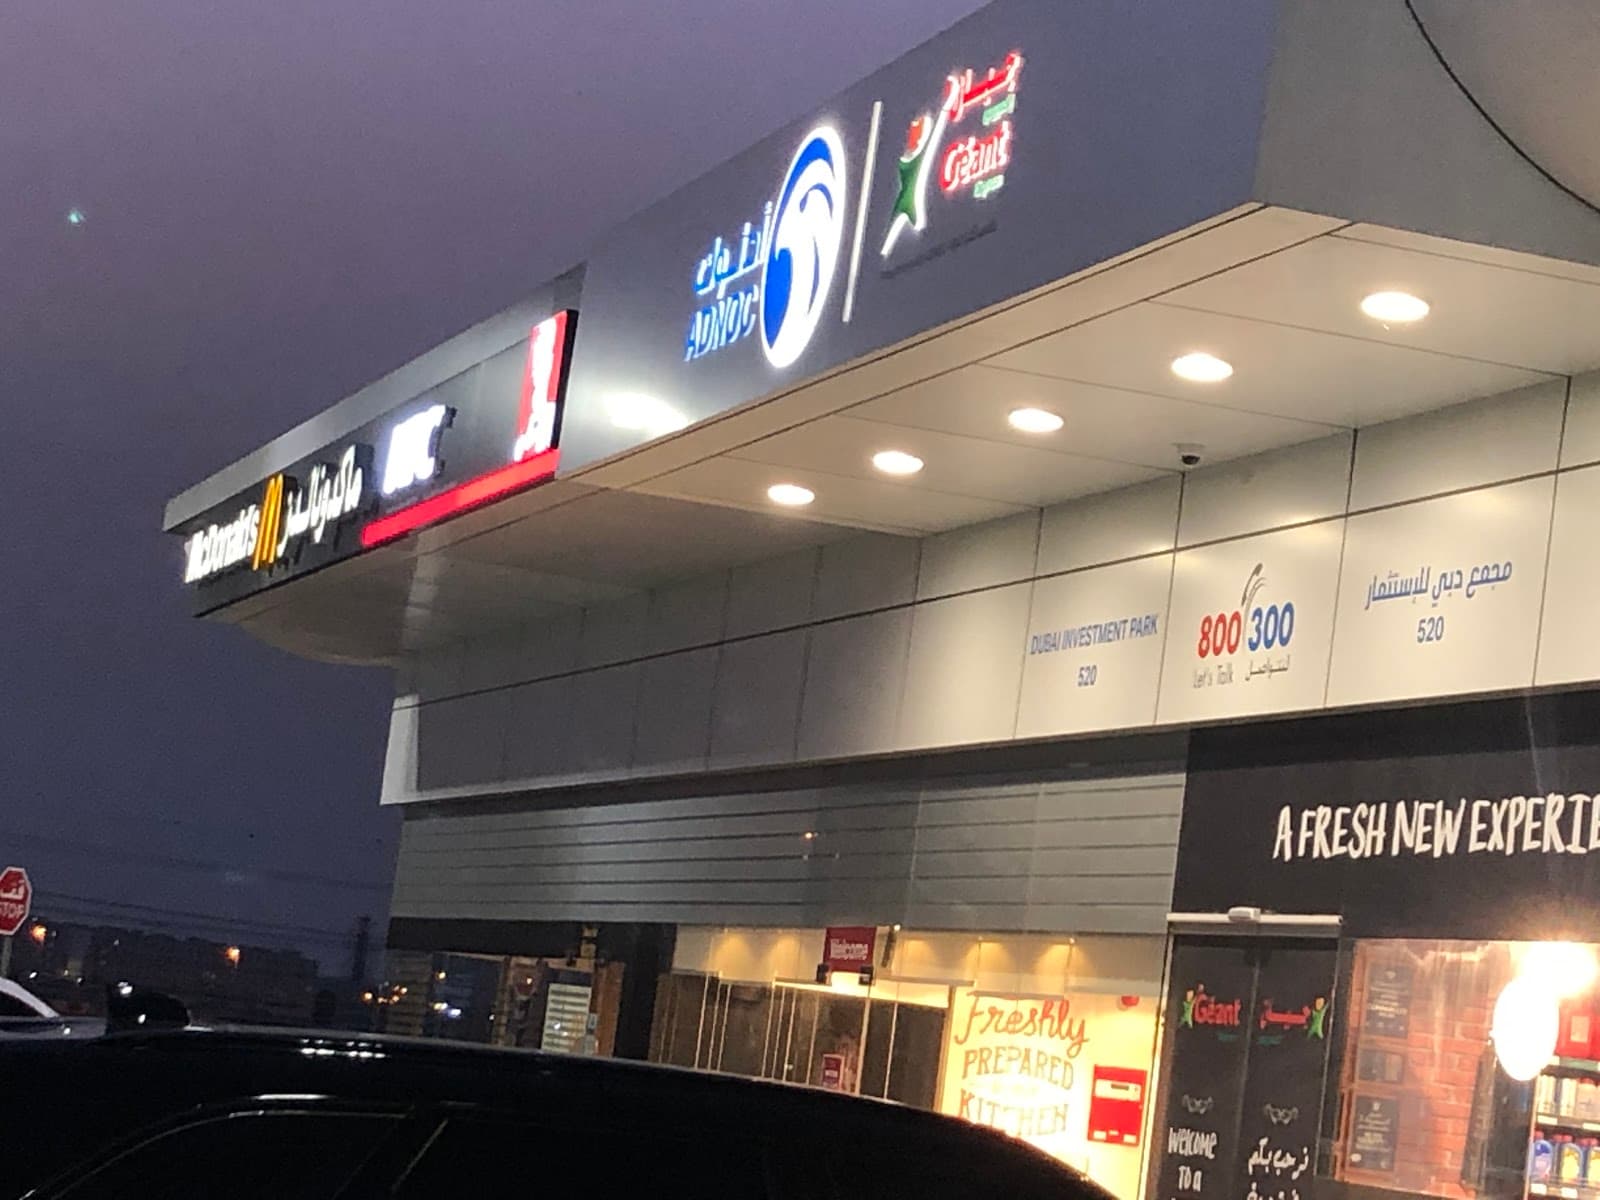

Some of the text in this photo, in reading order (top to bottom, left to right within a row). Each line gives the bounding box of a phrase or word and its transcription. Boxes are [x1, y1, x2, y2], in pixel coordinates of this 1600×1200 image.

[683, 285, 759, 362] ADNOC
[1432, 568, 1463, 607] دبي
[1466, 561, 1513, 599] مجمع
[1030, 613, 1158, 655] DUBAI INVESTMENT PARK
[1198, 601, 1294, 658] 800 300
[1417, 615, 1445, 643] 520
[1077, 665, 1097, 687] 520
[1272, 804, 1293, 862] A
[1297, 801, 1388, 860] FRESH
[1391, 798, 1466, 859] NEW
[954, 990, 1089, 1057] Freshly
[962, 1045, 1074, 1091] PREPARED
